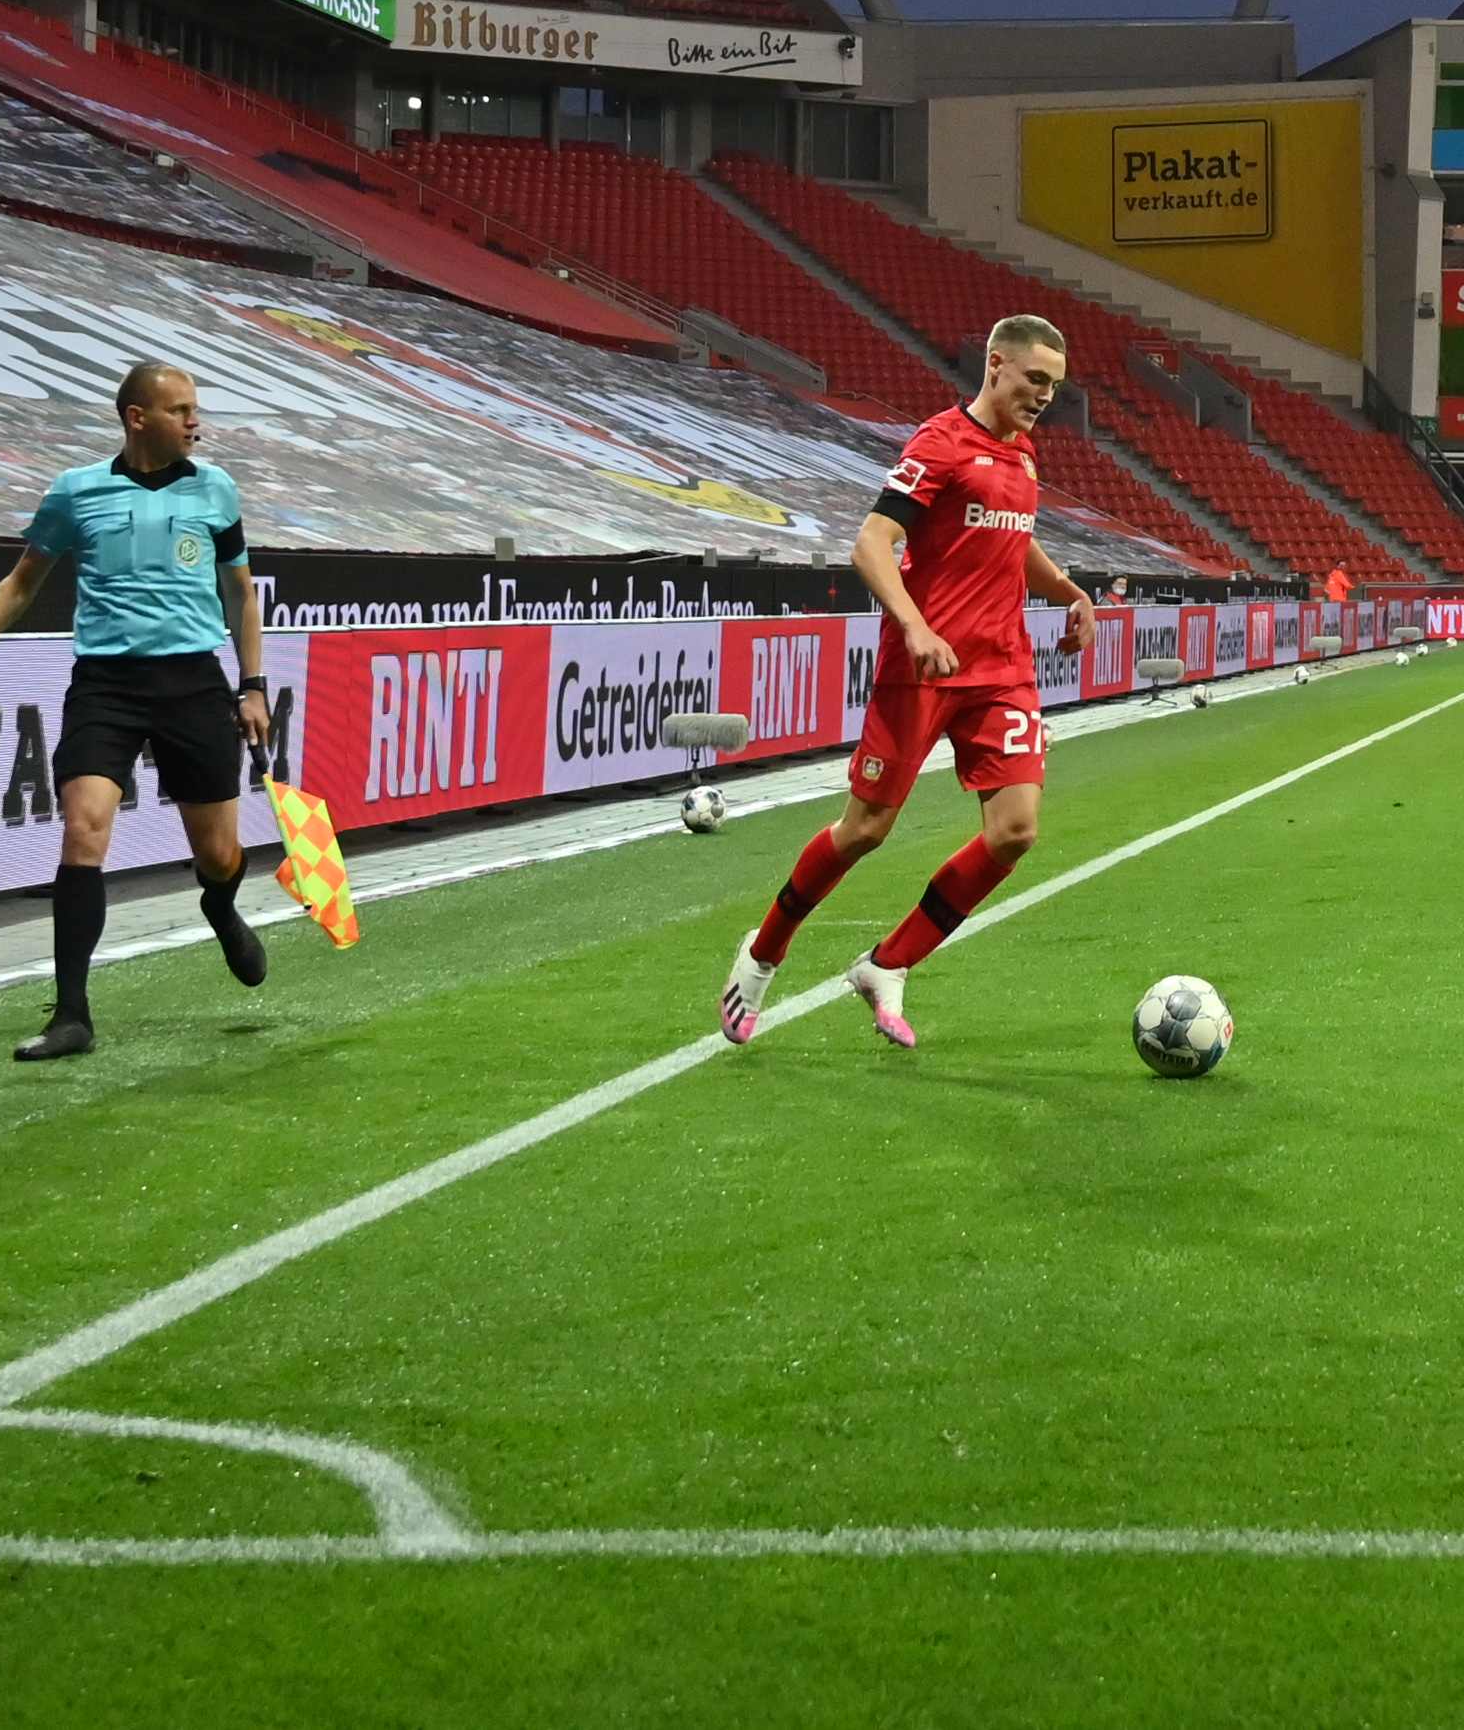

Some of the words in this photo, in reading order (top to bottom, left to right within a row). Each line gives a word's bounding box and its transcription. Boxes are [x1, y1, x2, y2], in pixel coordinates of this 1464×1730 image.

[412, 1, 599, 61] Bitburger
[668, 38, 715, 66] Bitte
[722, 46, 755, 58] ein
[760, 32, 797, 56] Bit
[1123, 150, 1258, 183] Plakat-
[1123, 189, 1258, 211] verkauft.de
[964, 503, 1035, 532] Barmen
[433, 574, 491, 622] und
[748, 634, 821, 741] RINTI
[364, 646, 503, 804] RINTI
